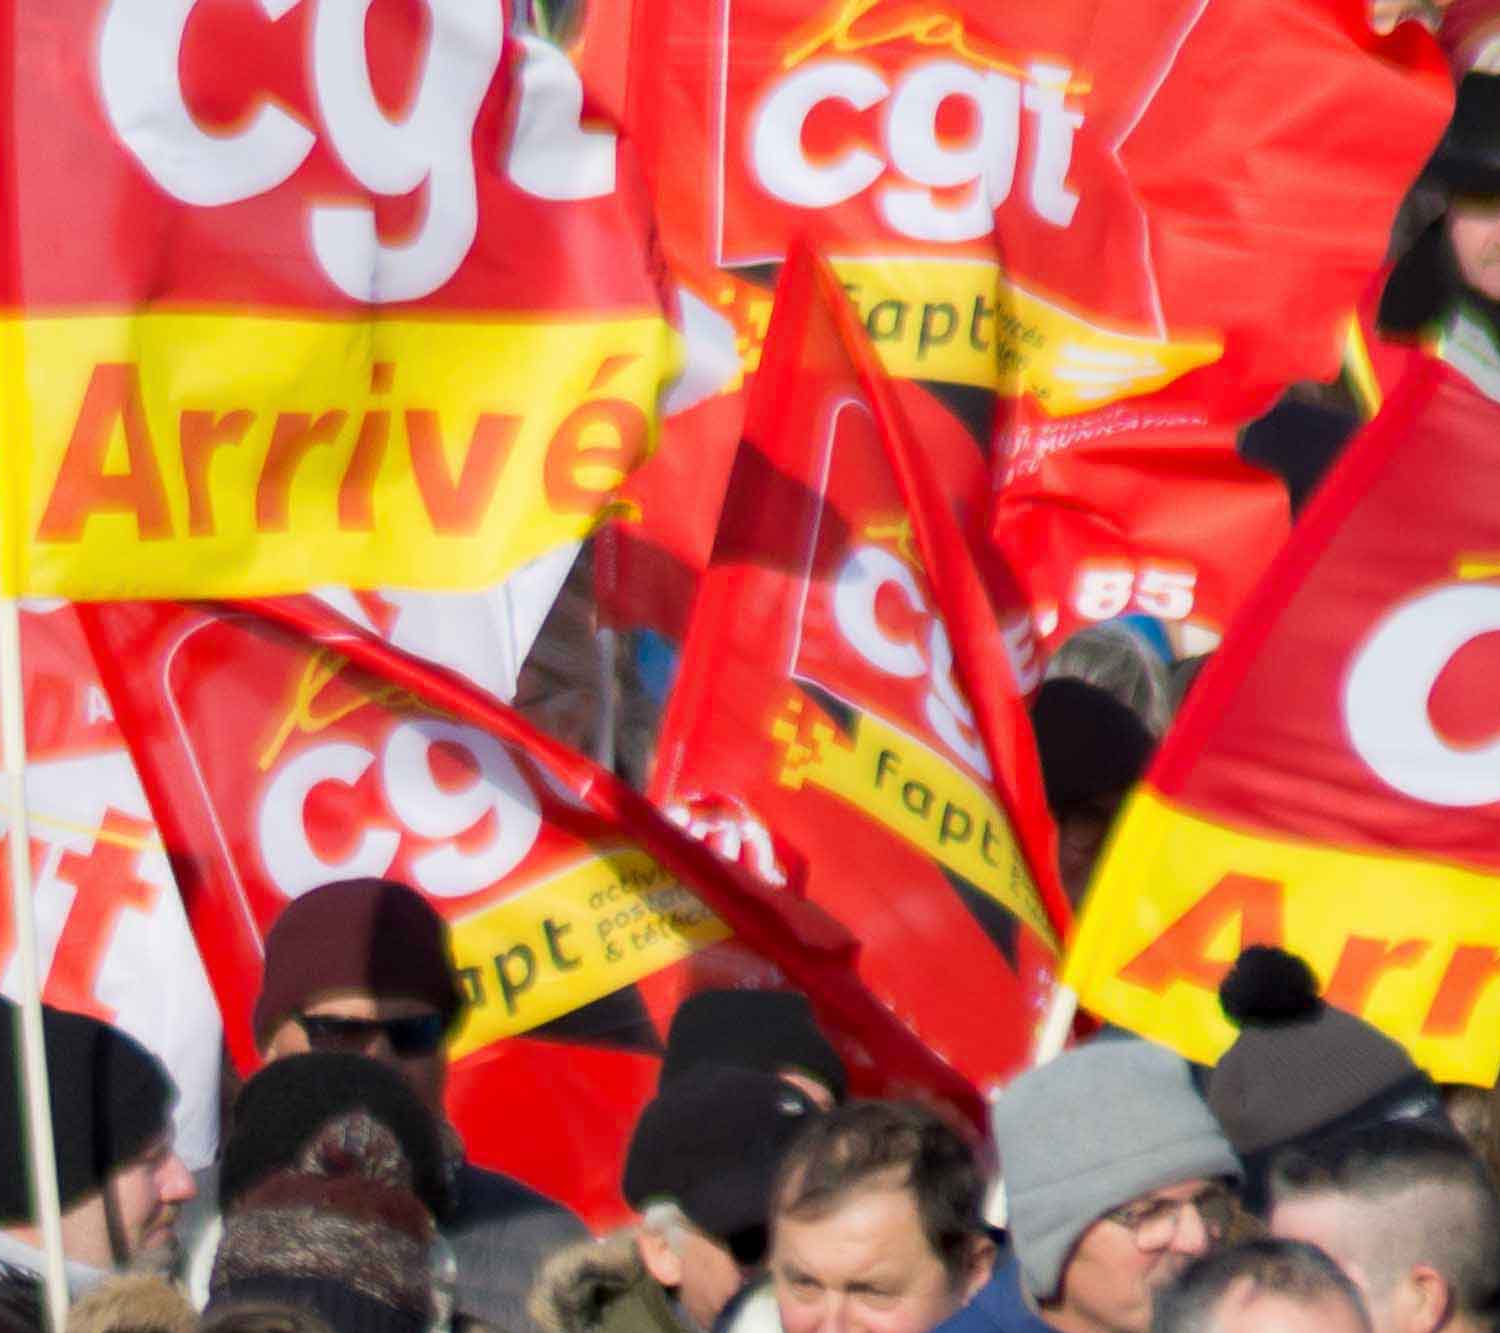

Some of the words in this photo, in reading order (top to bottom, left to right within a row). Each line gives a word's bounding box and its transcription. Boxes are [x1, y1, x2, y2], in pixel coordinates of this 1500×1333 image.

[752, 60, 1085, 243] cgt
[35, 355, 655, 542] Arrivé
[1075, 567, 1197, 622] 85
[871, 748, 1003, 868] fapt
